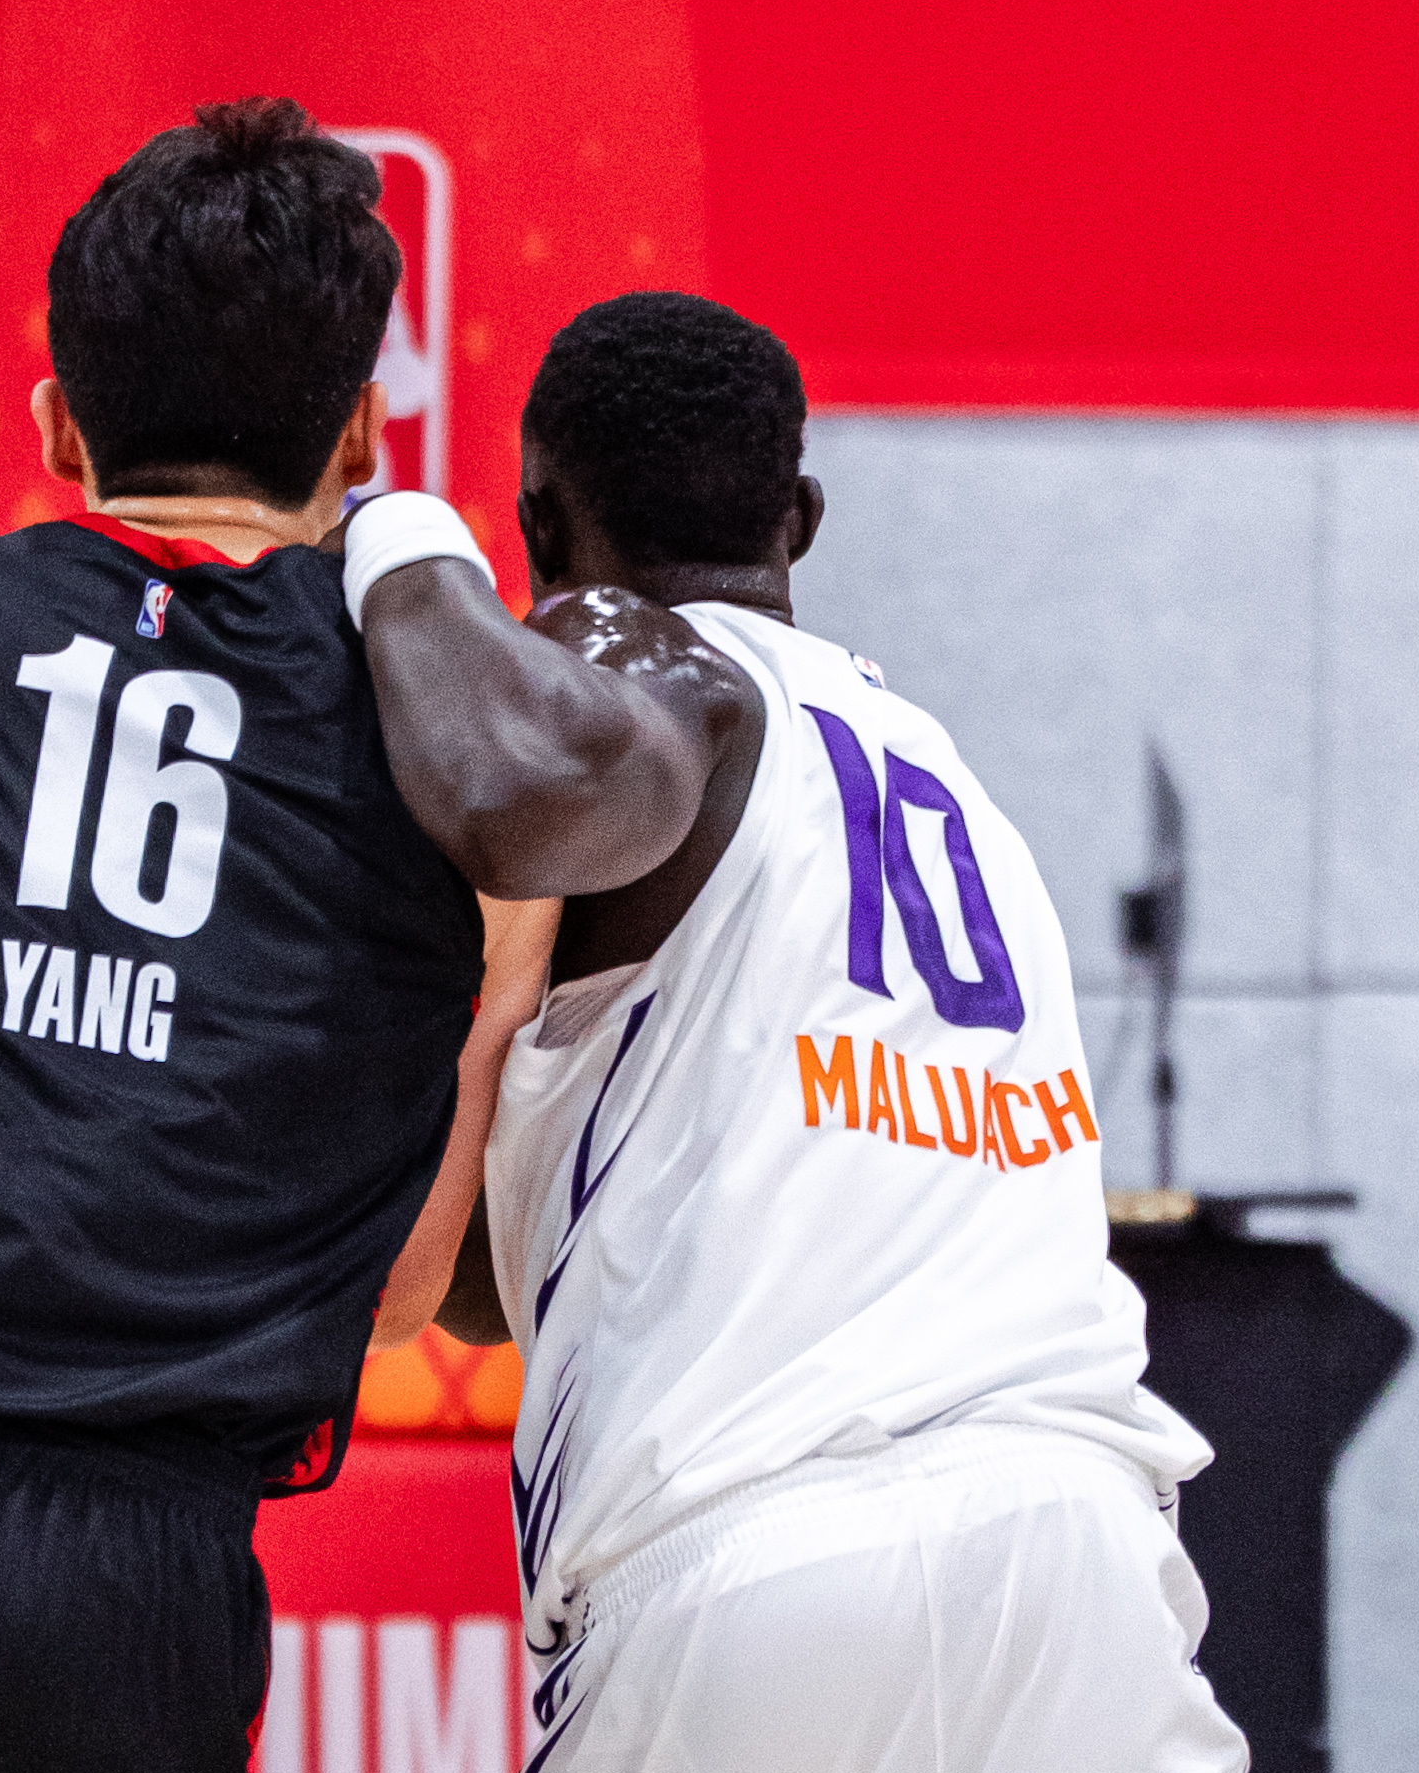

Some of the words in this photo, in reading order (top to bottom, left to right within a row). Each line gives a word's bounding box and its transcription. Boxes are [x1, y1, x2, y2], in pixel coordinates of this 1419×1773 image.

[15, 633, 242, 938] 16
[800, 703, 1026, 1034] 10
[2, 940, 177, 1063] YANG
